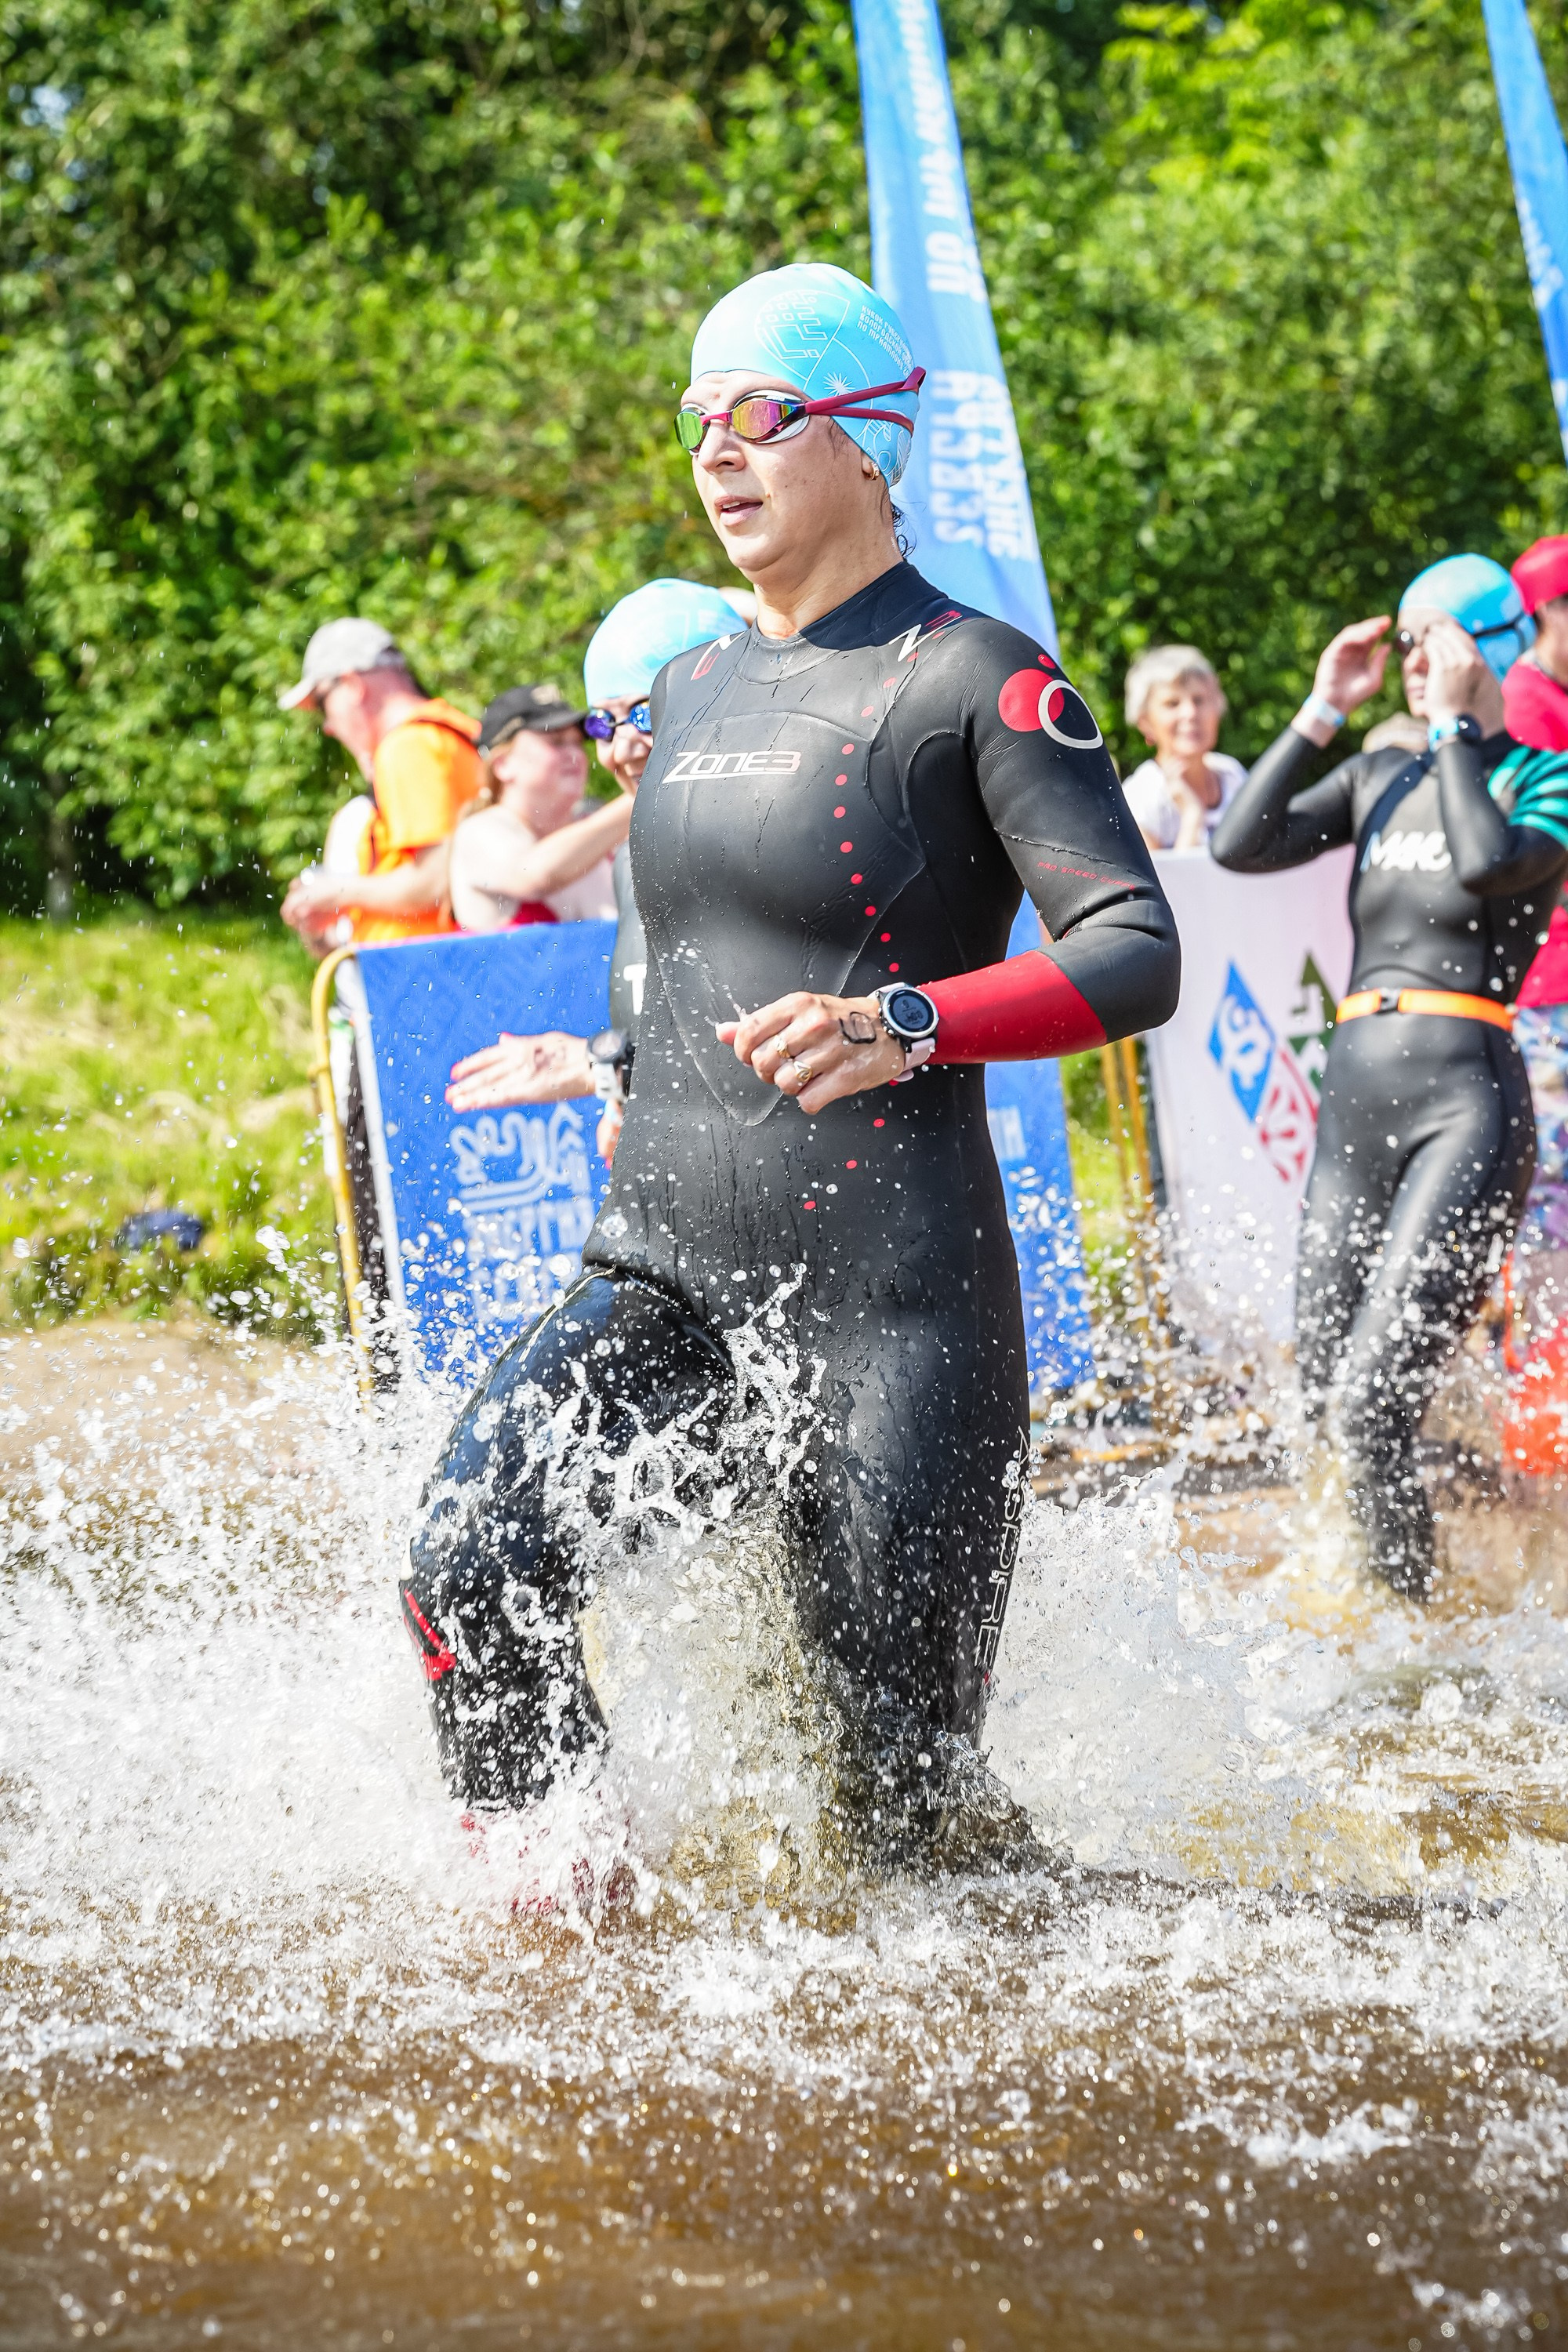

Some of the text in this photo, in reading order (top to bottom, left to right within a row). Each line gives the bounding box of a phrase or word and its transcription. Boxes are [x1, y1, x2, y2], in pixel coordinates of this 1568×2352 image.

[862, 305, 884, 325] КУБОК
[857, 321, 868, 332] ПО
[662, 750, 802, 784] ZONE3
[1037, 861, 1058, 872] PRO
[1060, 866, 1098, 880] SPEED
